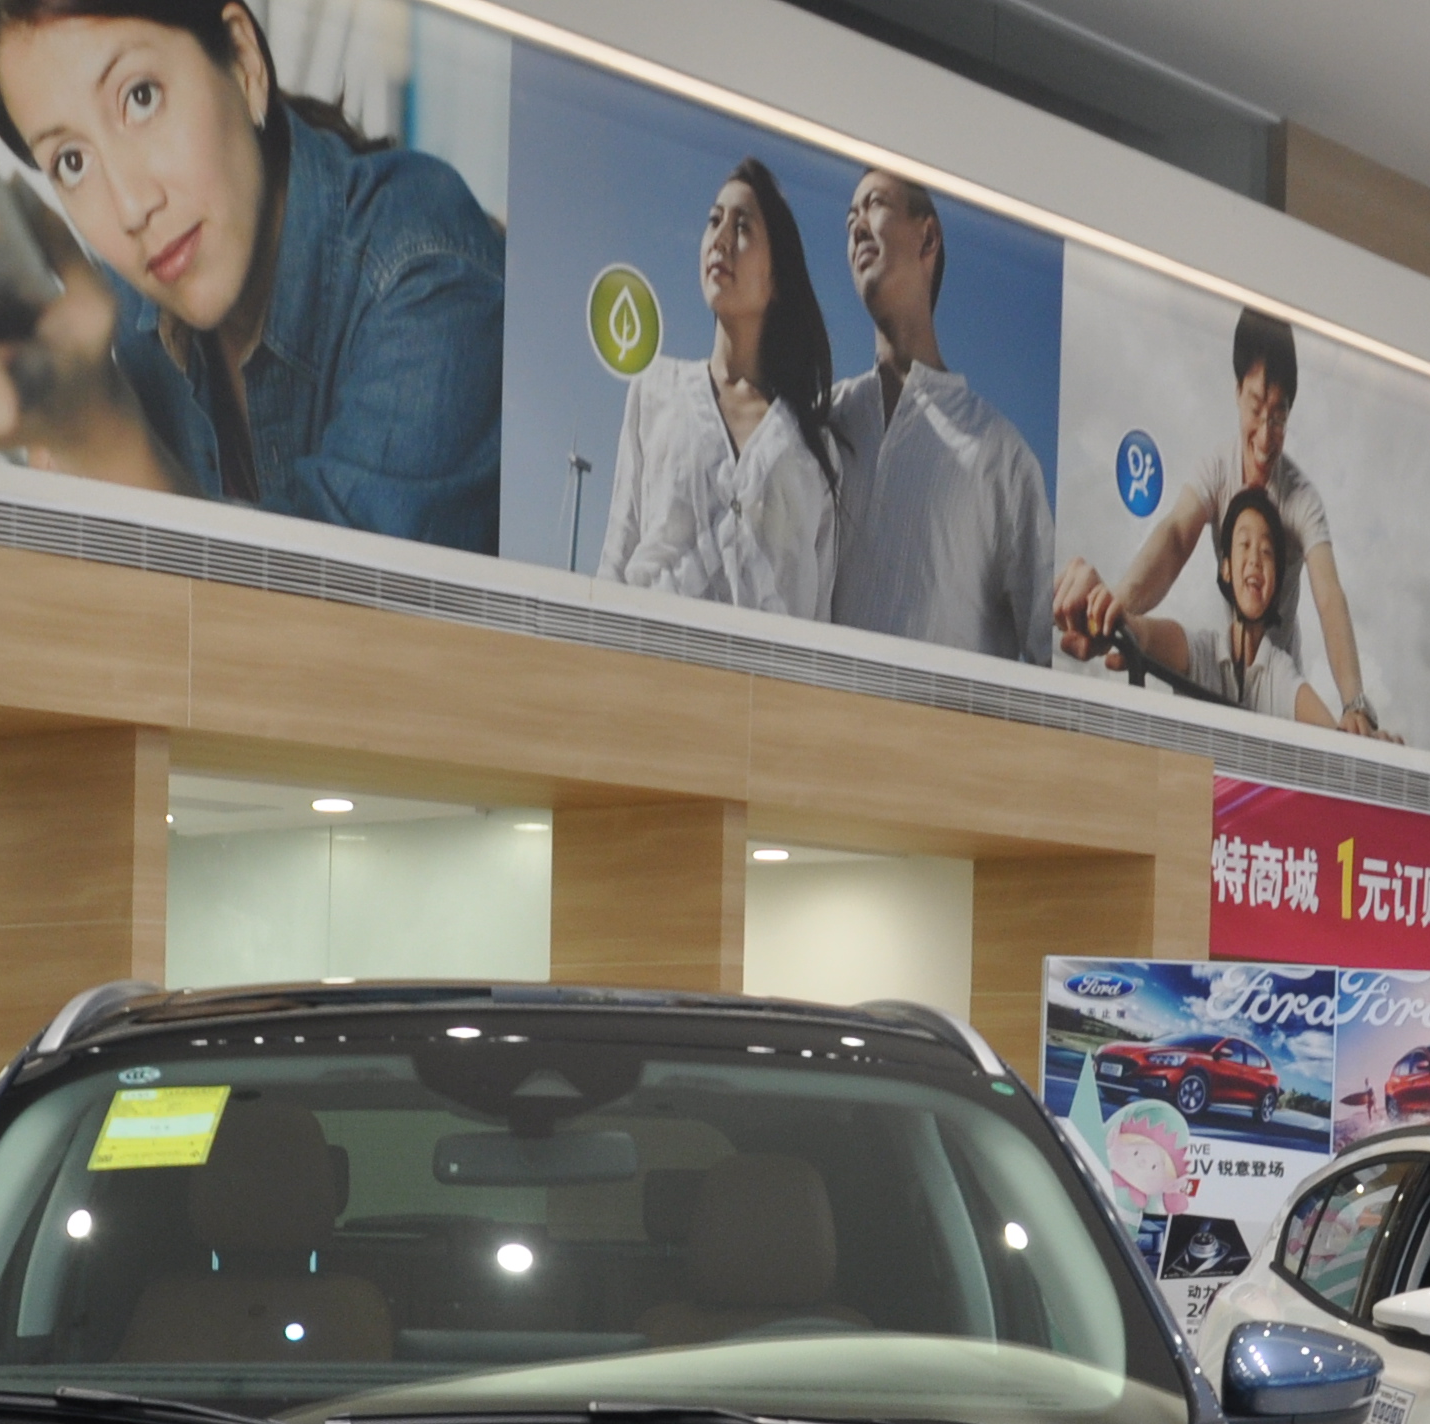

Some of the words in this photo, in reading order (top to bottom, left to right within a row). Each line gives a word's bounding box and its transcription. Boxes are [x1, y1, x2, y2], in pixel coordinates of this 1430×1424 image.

[1212, 834, 1319, 914] 特商城
[1217, 1160, 1285, 1178] 锐意登场
